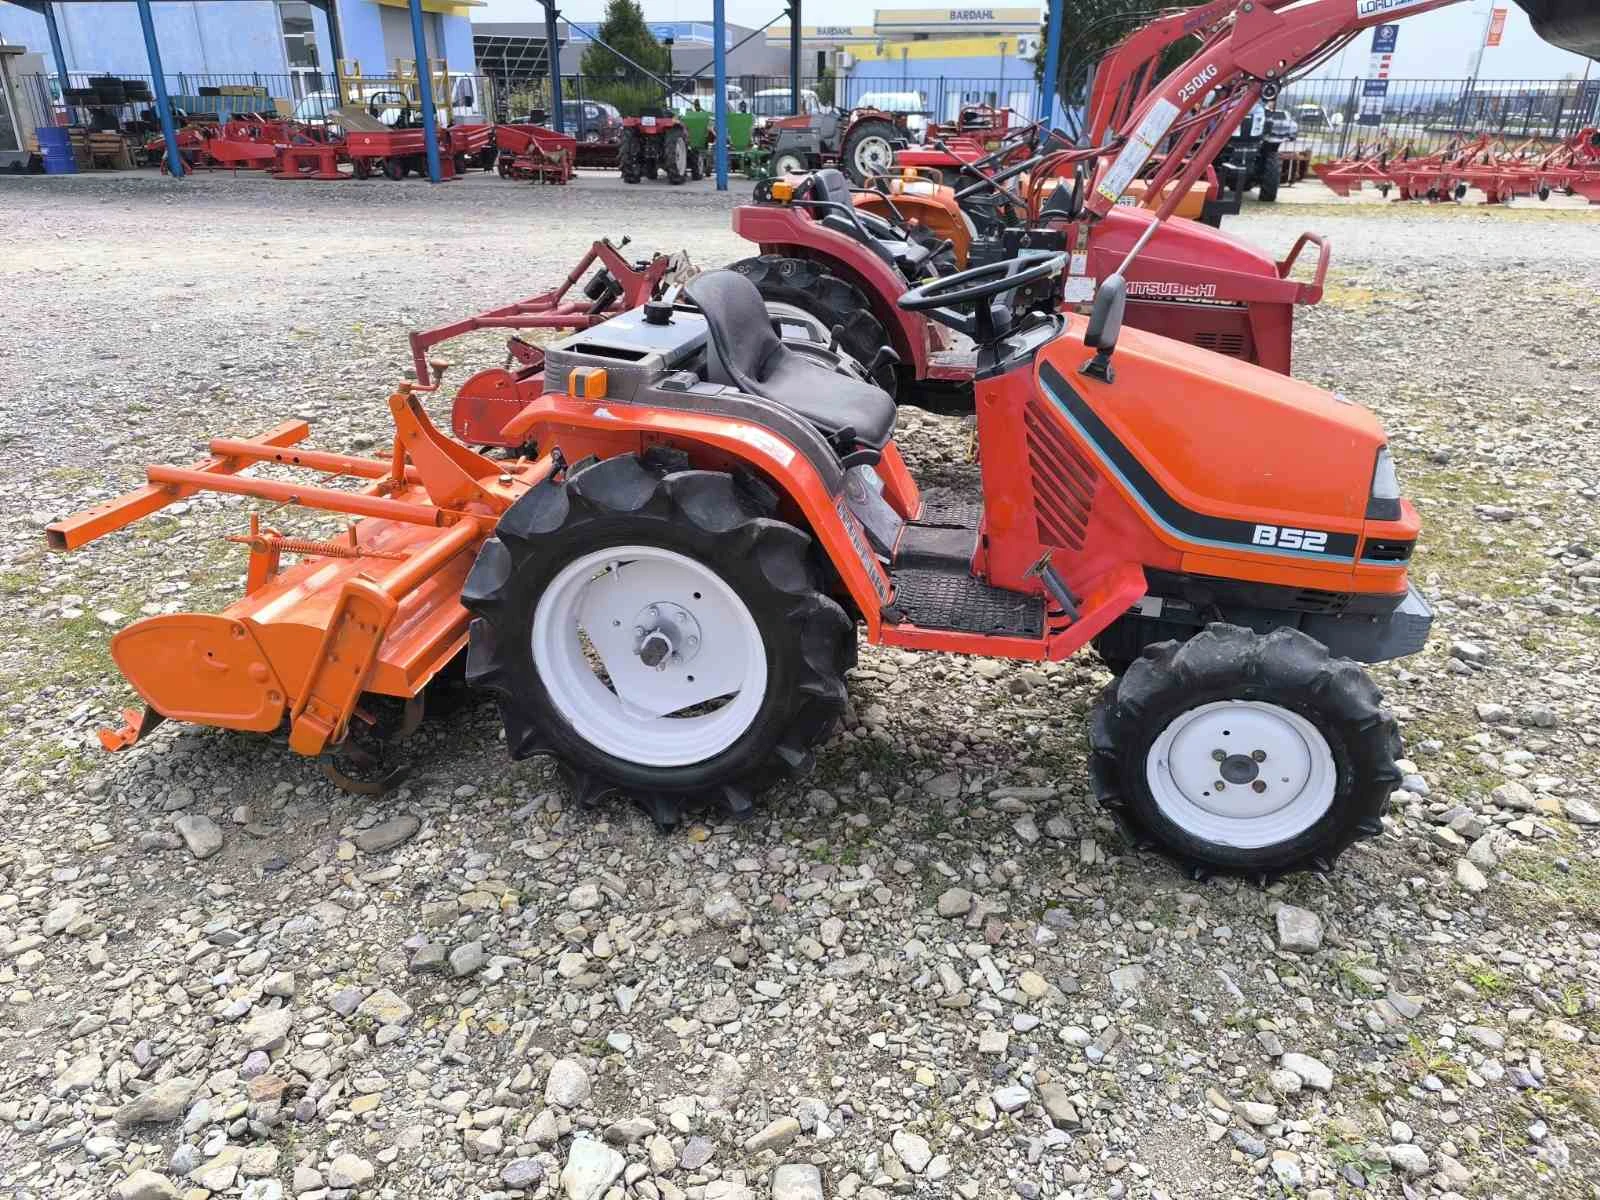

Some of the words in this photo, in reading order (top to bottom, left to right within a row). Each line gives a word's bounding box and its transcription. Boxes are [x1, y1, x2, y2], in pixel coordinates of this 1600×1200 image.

[950, 9, 996, 20] BARDAHL
[1177, 63, 1218, 103] 250KG
[1251, 524, 1328, 552] B52
